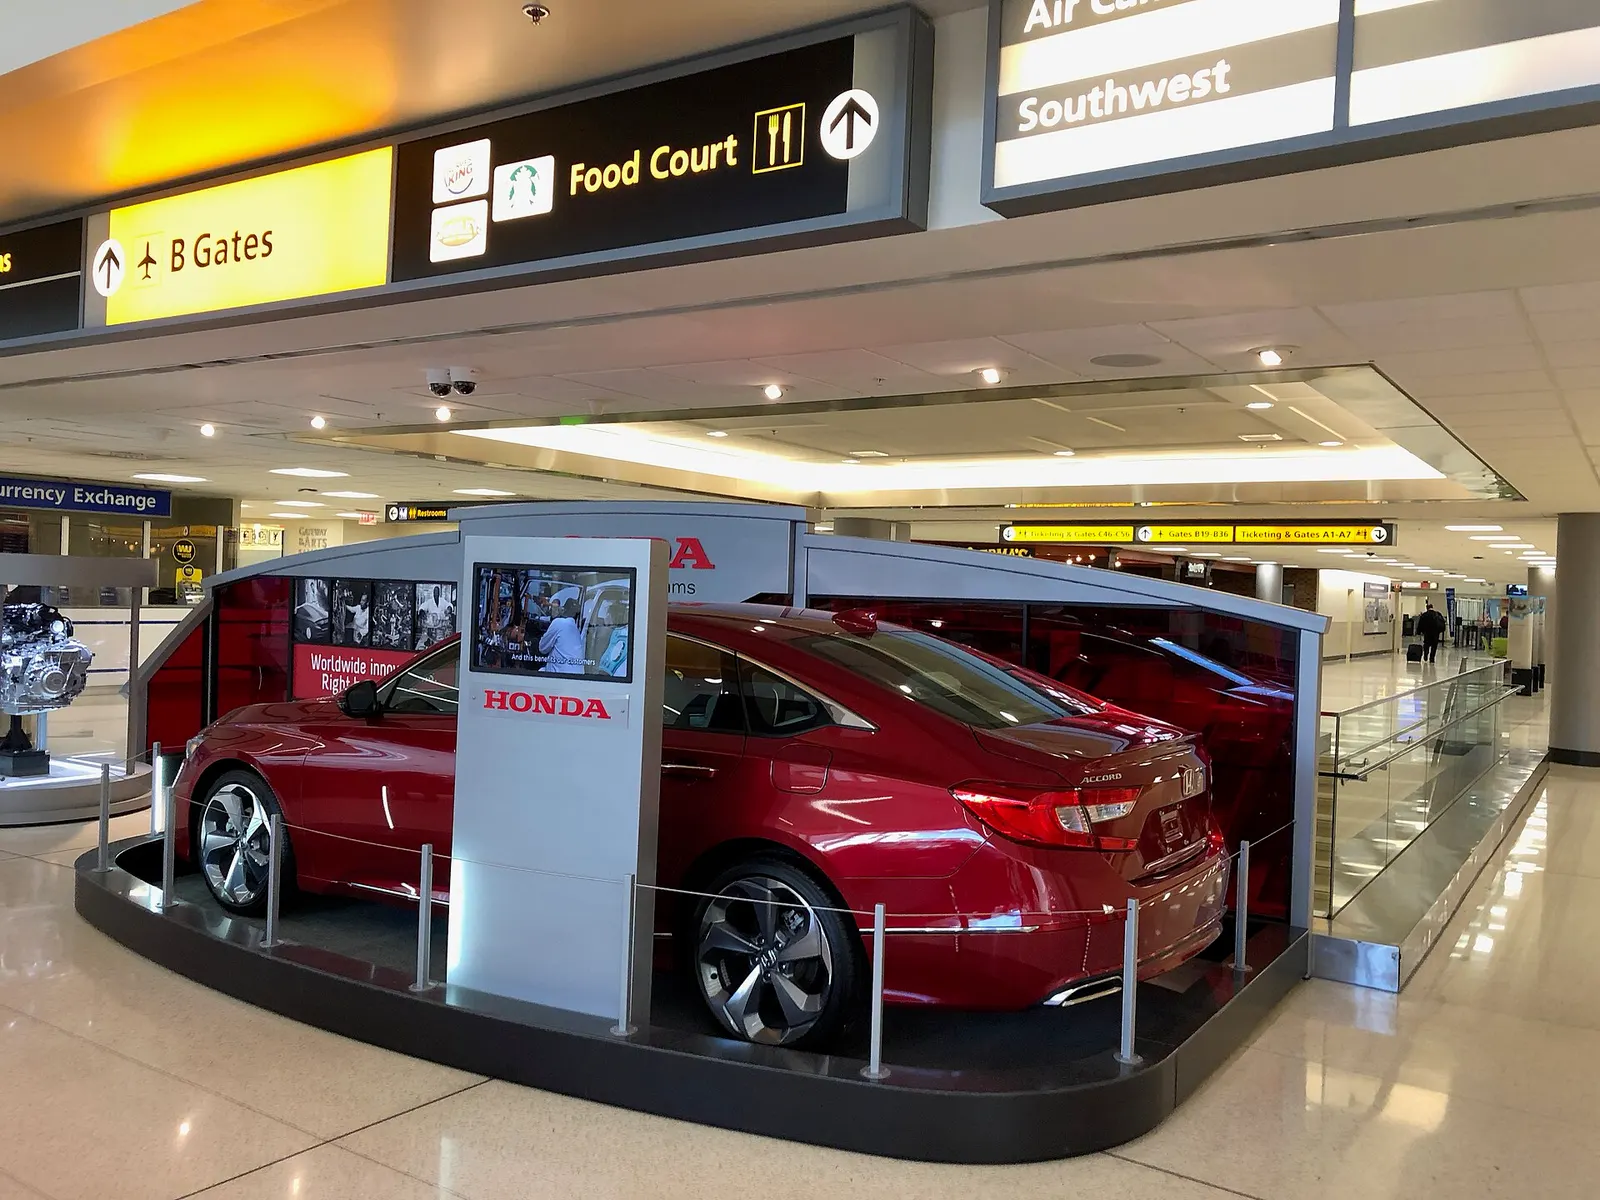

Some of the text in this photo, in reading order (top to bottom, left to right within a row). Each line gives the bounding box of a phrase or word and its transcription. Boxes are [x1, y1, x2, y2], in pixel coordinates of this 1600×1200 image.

[1023, 0, 1079, 33] Air
[1018, 58, 1231, 132] Southwest
[570, 134, 738, 196] Food Court
[171, 230, 273, 272] B Gates
[74, 488, 156, 511] Exchange
[417, 509, 447, 522] Restrooms
[1075, 530, 1096, 538] Gates
[1168, 530, 1229, 538] Gates B19-B36
[1241, 530, 1352, 540] Ticketing & Gates A1-A7
[311, 652, 367, 674] Worldwide
[511, 653, 523, 661] And
[523, 654, 533, 662] this
[568, 658, 596, 666] customers
[321, 673, 350, 695] Right
[483, 690, 612, 719] HONDA
[1080, 772, 1123, 785] ACCORD
